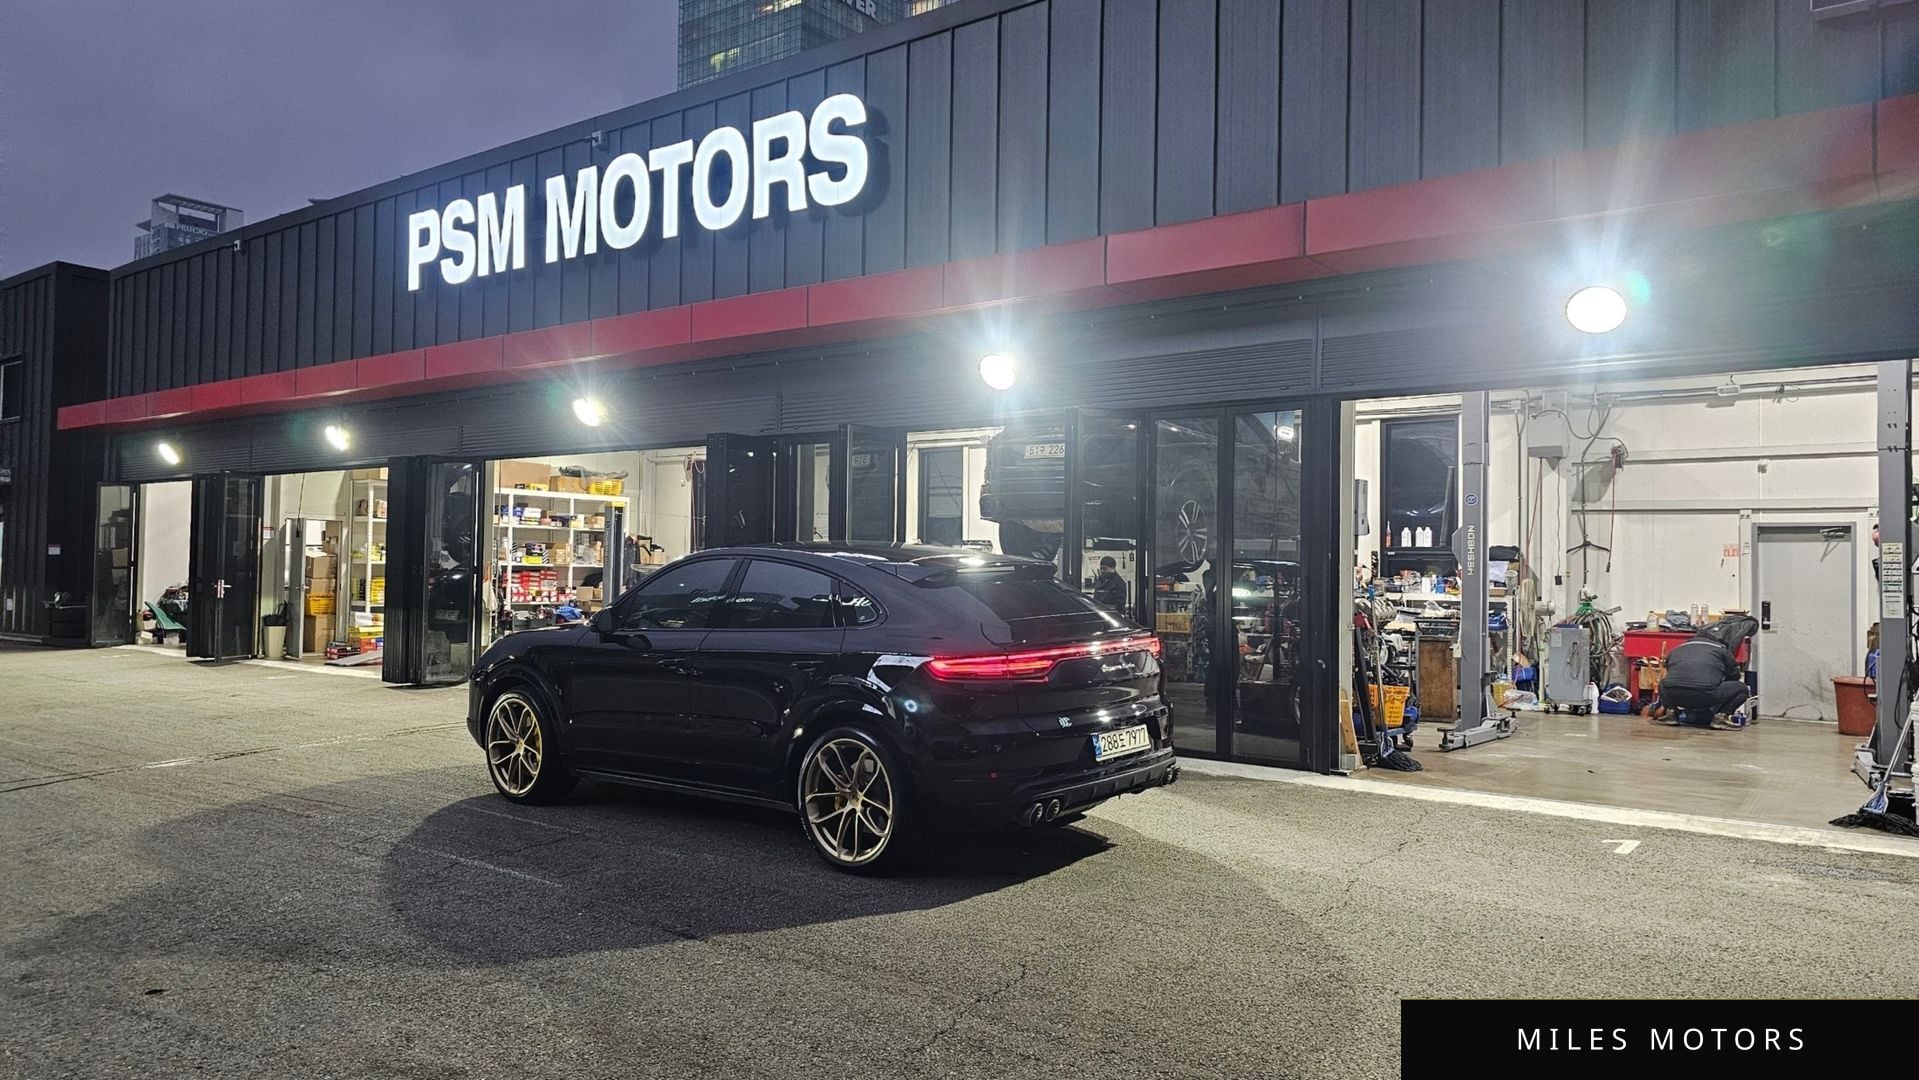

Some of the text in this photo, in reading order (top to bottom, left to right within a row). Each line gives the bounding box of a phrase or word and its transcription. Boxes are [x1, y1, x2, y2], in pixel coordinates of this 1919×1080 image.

[408, 93, 868, 291] PSM MOTORS
[1467, 525, 1475, 576] HESHBON
